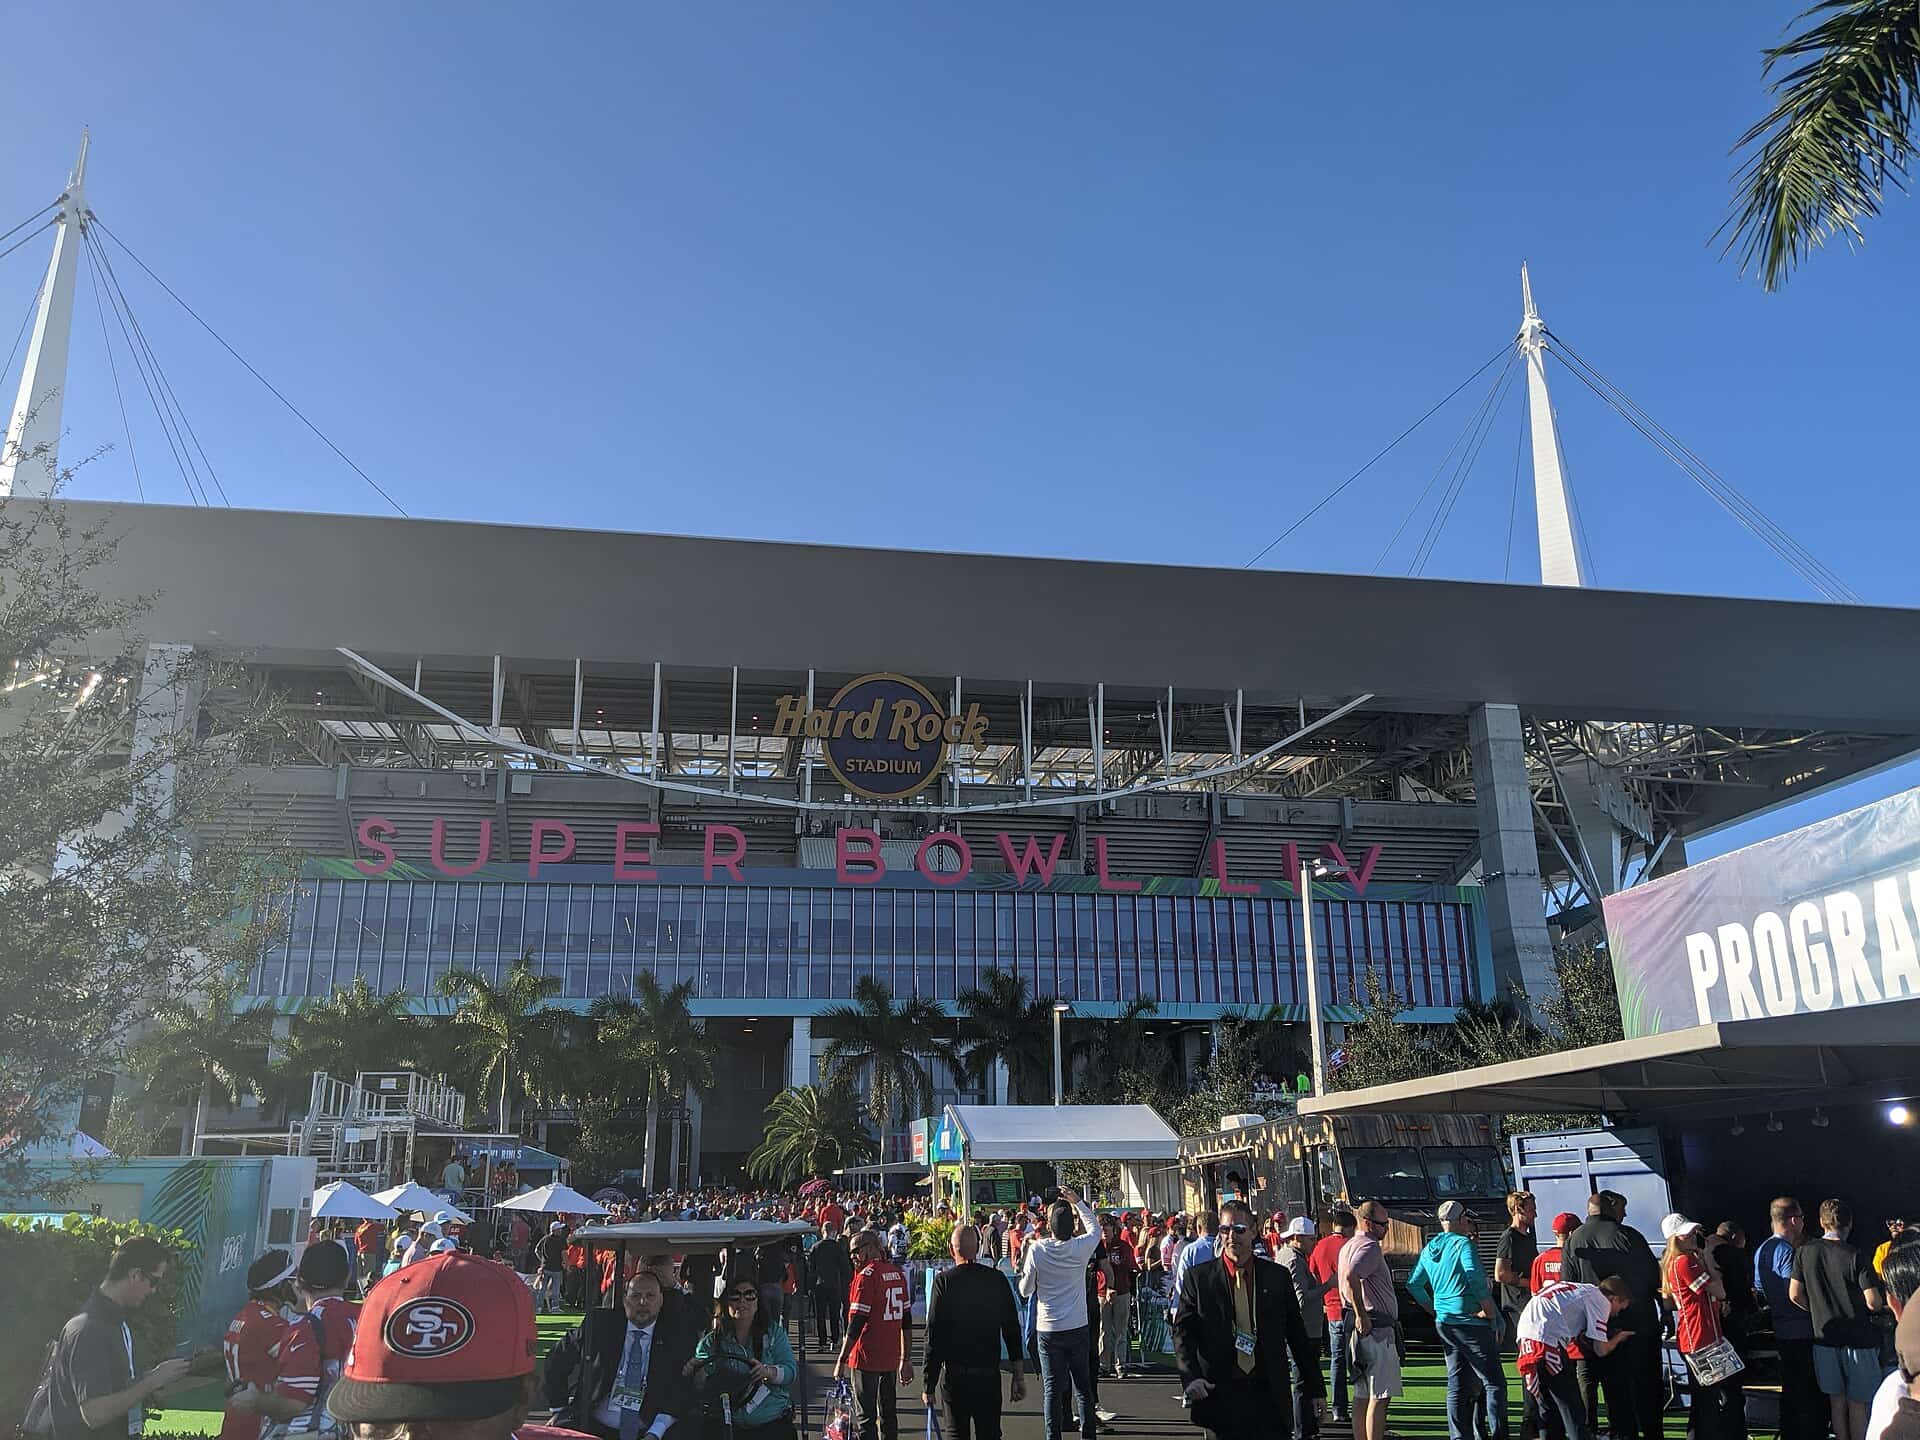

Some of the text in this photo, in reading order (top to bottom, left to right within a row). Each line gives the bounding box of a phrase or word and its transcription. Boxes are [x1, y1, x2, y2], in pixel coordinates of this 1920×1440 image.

[772, 694, 990, 752] Hard Rock
[846, 758, 921, 774] STADIUM
[355, 817, 1384, 897] SUPER BOWL LIV
[1685, 870, 1920, 1026] PROGRA
[883, 1287, 903, 1320] 15
